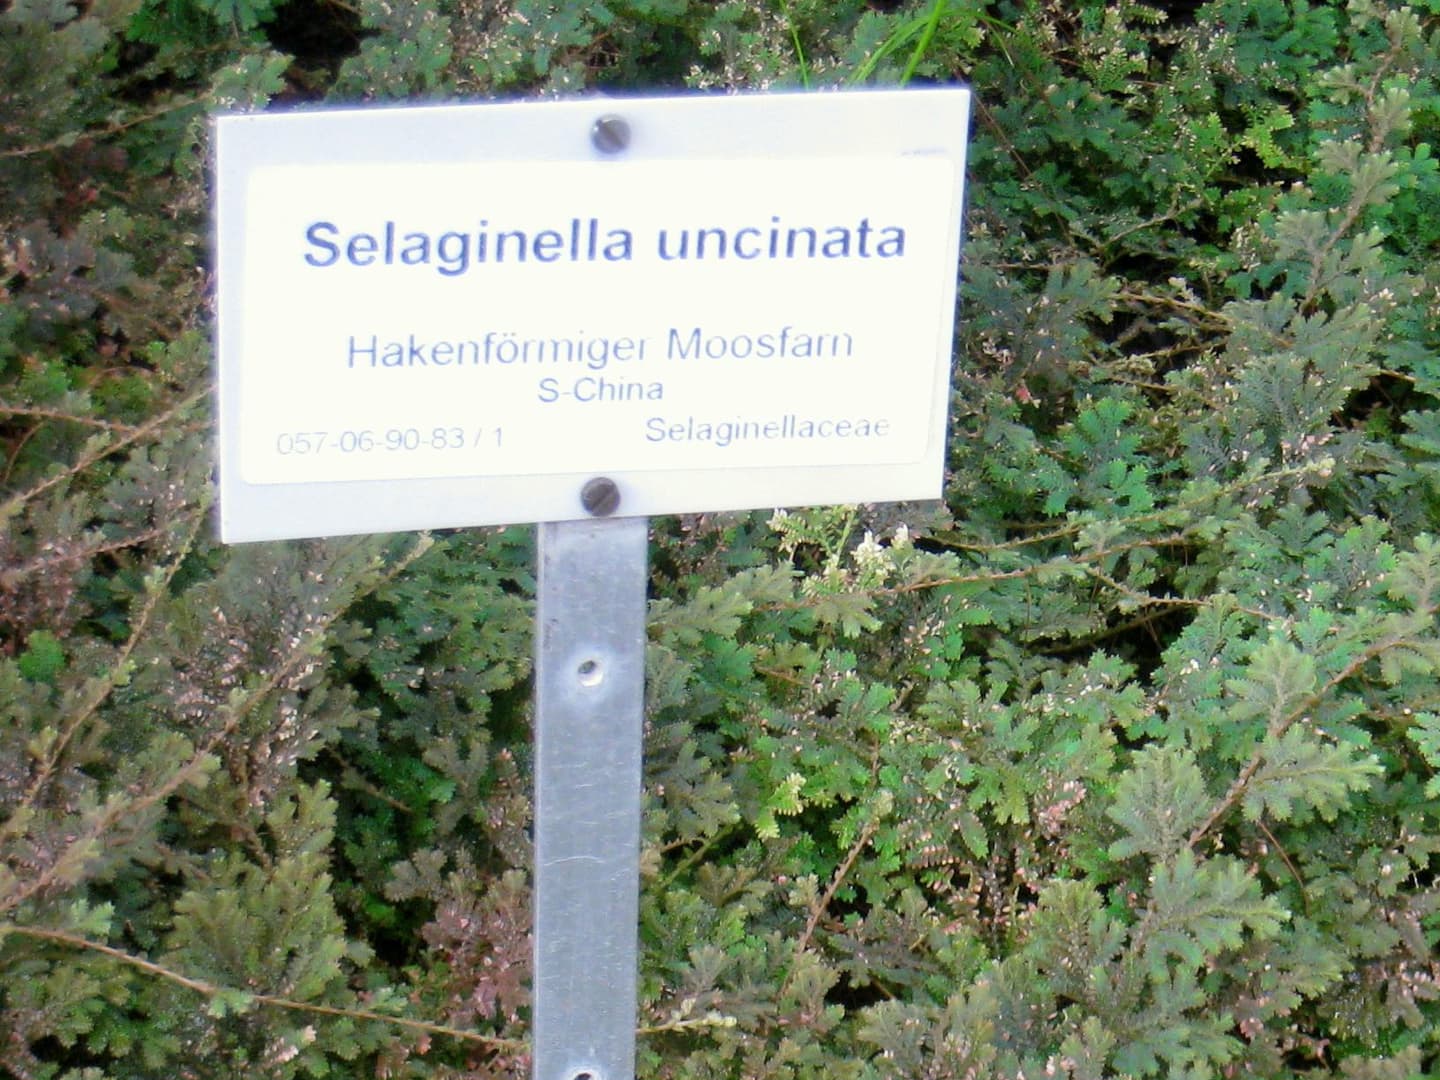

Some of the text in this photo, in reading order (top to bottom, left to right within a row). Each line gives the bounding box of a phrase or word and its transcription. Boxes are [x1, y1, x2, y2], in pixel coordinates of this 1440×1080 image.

[304, 216, 907, 277] Selaginella uncinata
[347, 325, 854, 371] Hakenförmiger Moosfarn
[537, 376, 665, 404] S-China
[276, 428, 466, 455] 057-06-90-83
[645, 413, 890, 446] Selaginellaceae
